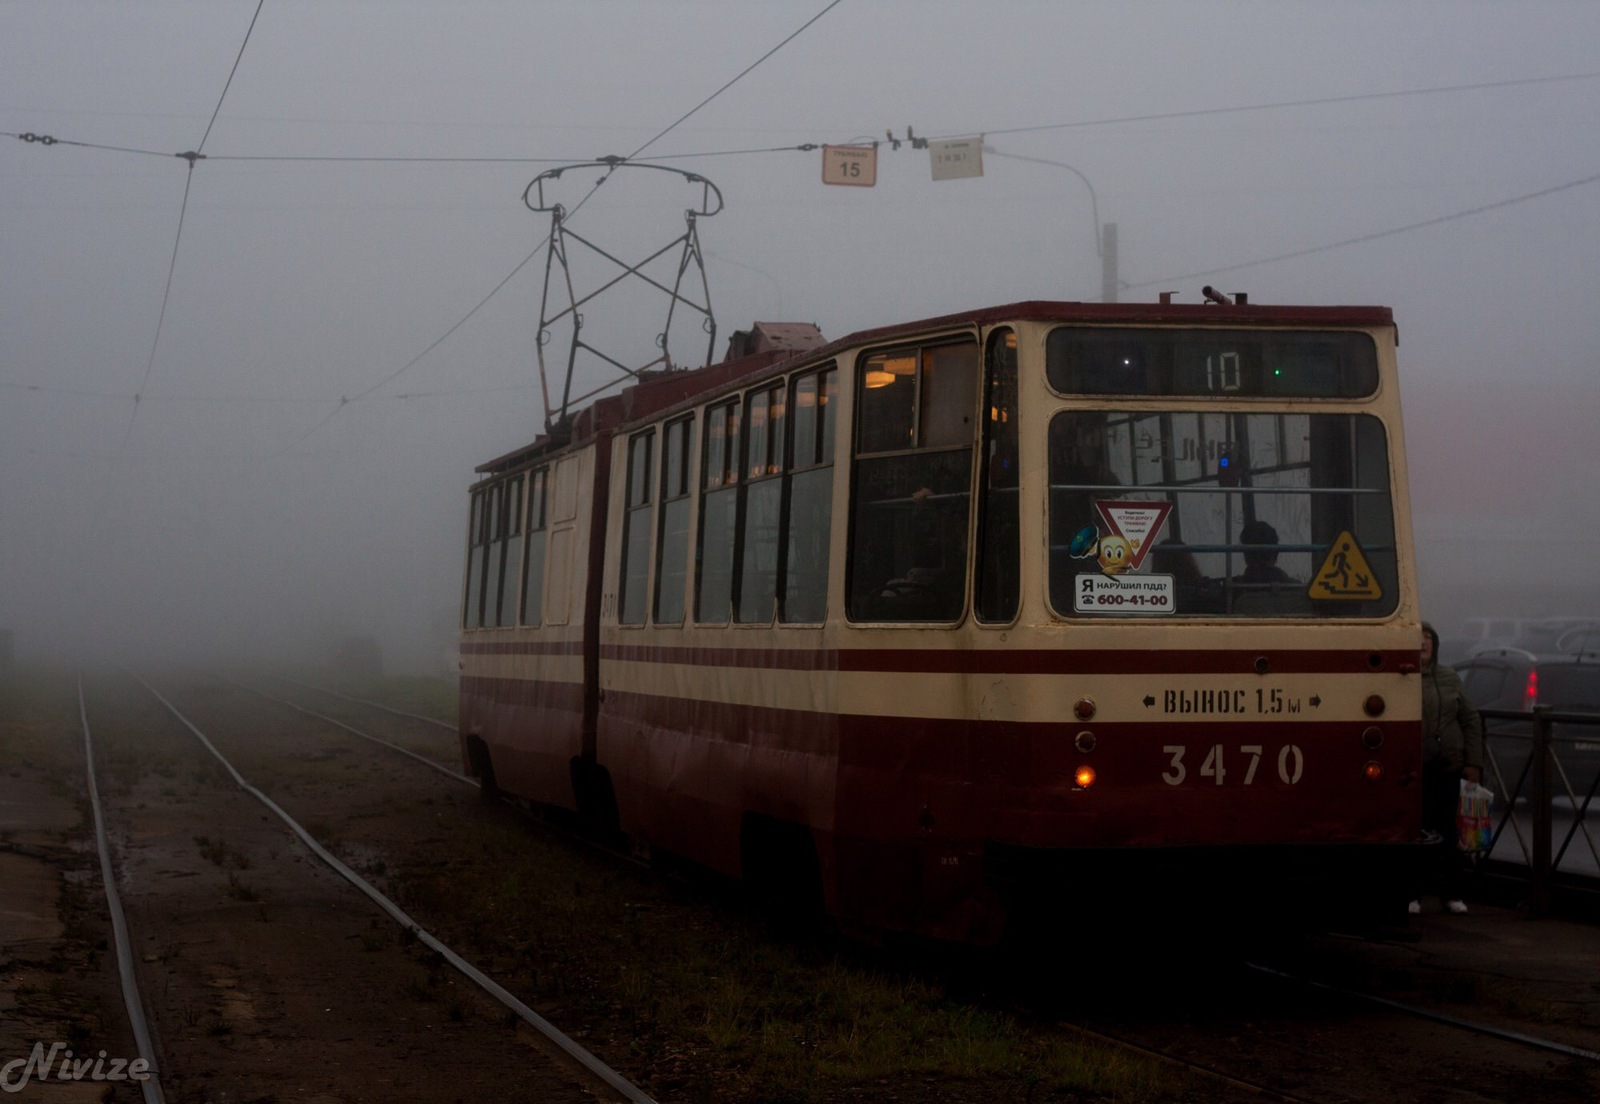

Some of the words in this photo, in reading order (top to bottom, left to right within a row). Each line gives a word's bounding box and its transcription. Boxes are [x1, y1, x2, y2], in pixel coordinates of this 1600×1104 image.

[840, 162, 860, 178] 15
[1206, 351, 1241, 391] 10
[1081, 579, 1094, 592] Я
[1096, 582, 1142, 590] НАРУШИЛ
[1143, 583, 1167, 591] ПДД?
[1097, 594, 1168, 606] 600-41-00
[1164, 690, 1246, 713] ВЫНОС
[1256, 688, 1283, 714] 1,5
[1161, 744, 1304, 786] 3470
